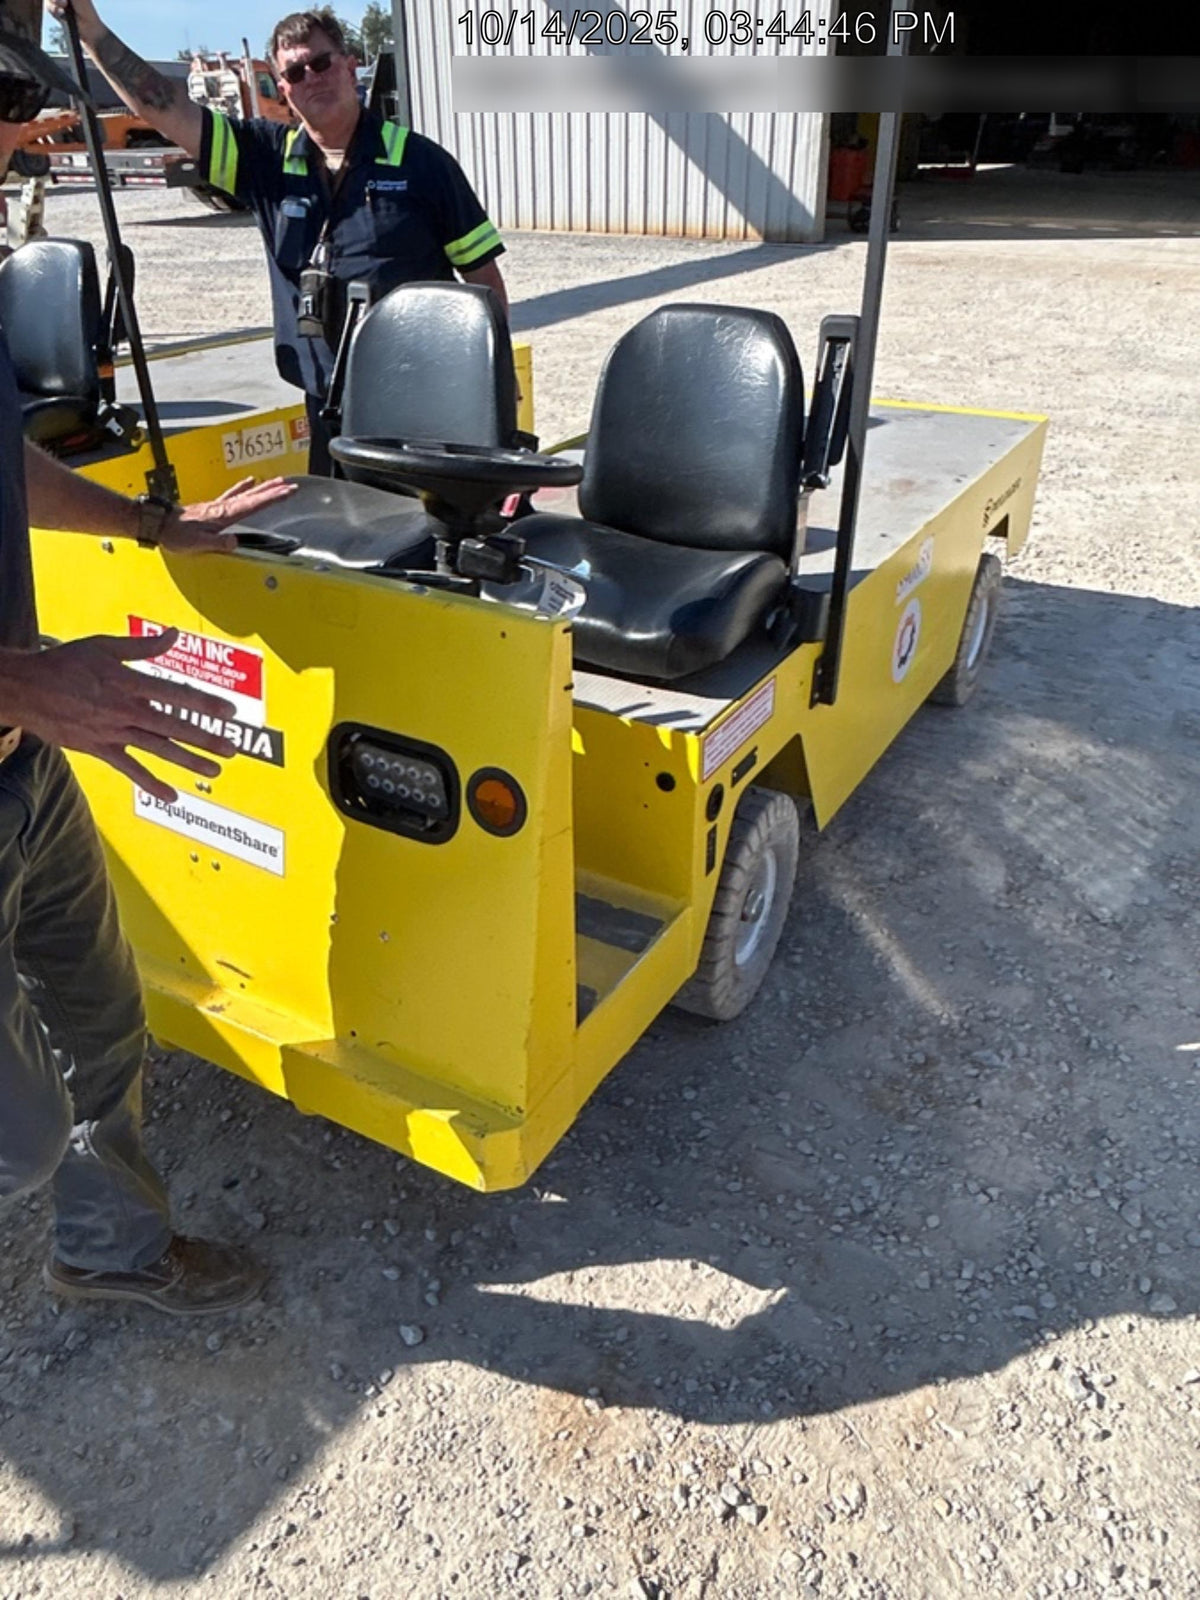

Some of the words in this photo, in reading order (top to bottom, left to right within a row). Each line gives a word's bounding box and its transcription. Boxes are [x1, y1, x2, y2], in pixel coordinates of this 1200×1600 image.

[225, 429, 284, 463] 376534
[206, 638, 235, 666] INC
[186, 664, 236, 689] EQUIPMENT
[154, 798, 279, 858] EquipmentShare
